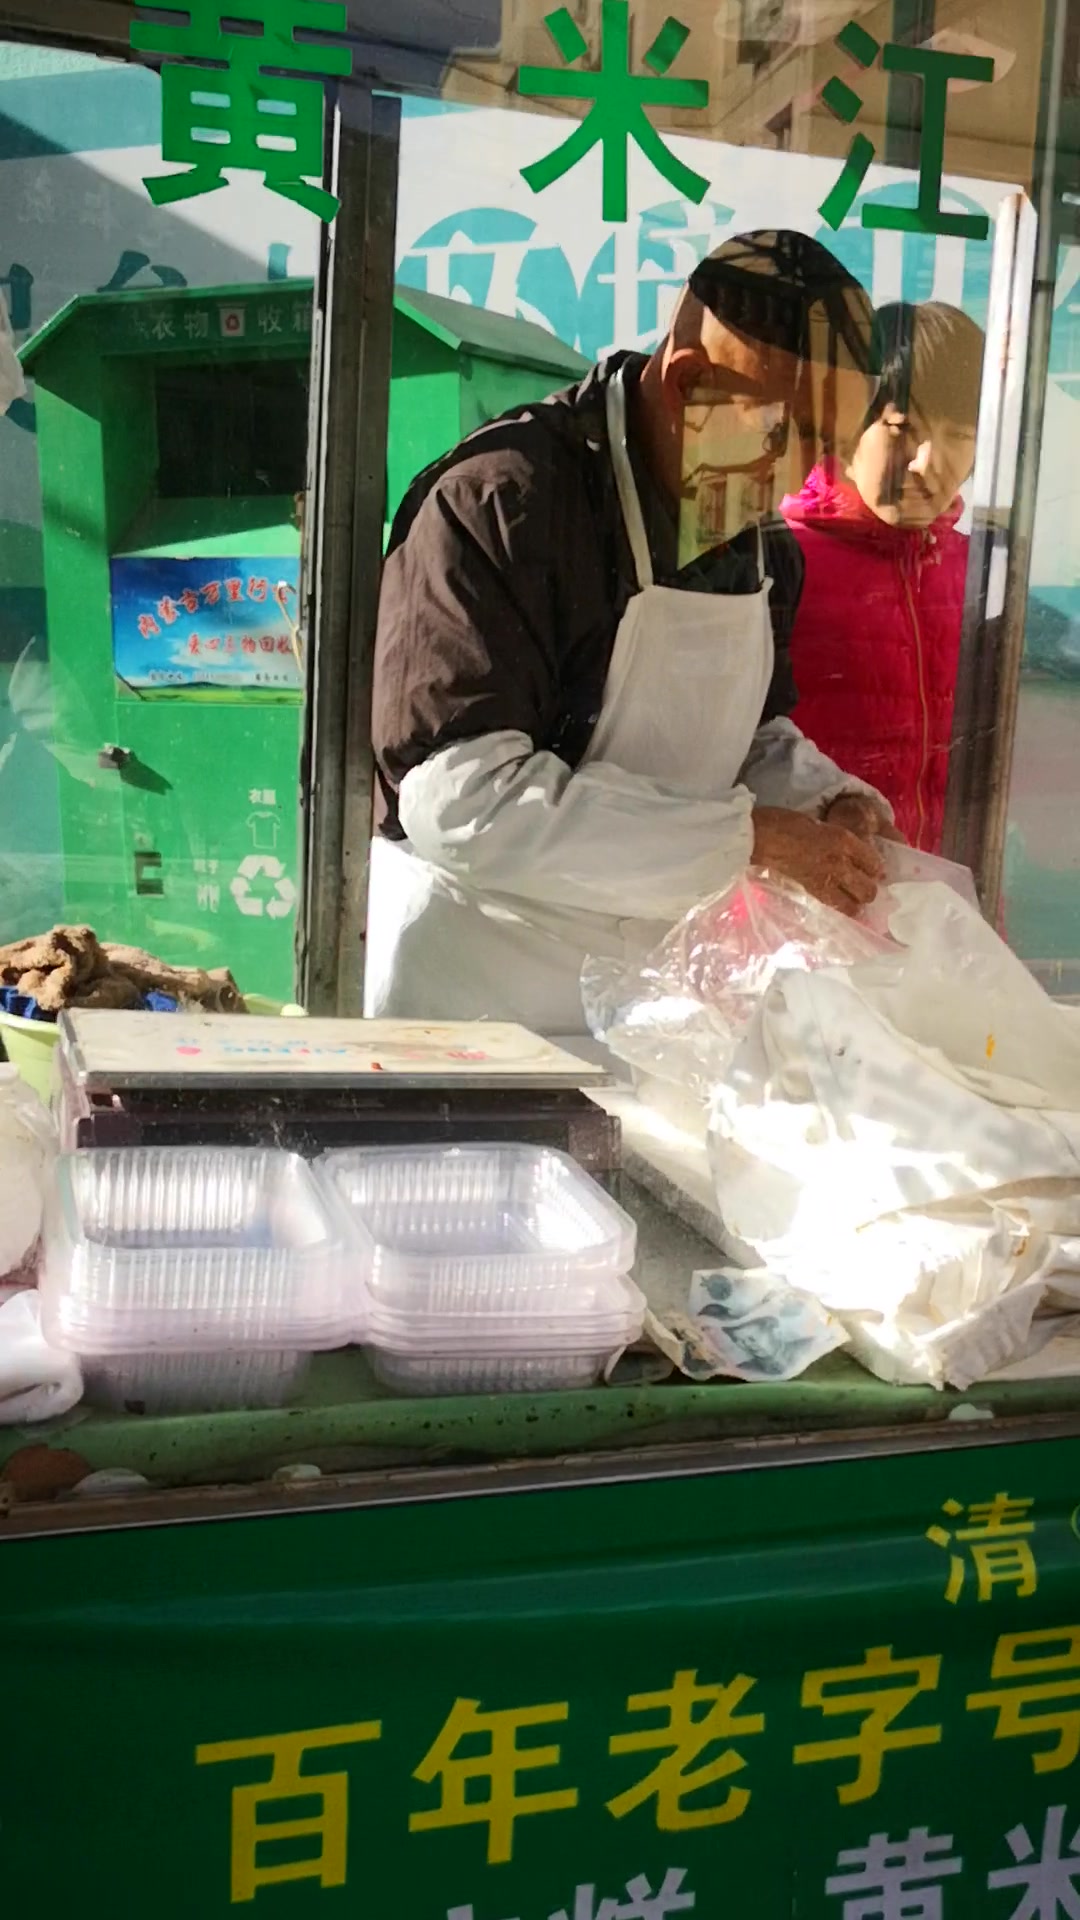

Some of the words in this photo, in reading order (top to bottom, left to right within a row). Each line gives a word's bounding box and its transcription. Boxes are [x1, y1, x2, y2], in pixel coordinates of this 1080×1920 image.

[925, 1492, 1036, 1605] 清
[195, 1625, 1080, 1904] 百年老字号
